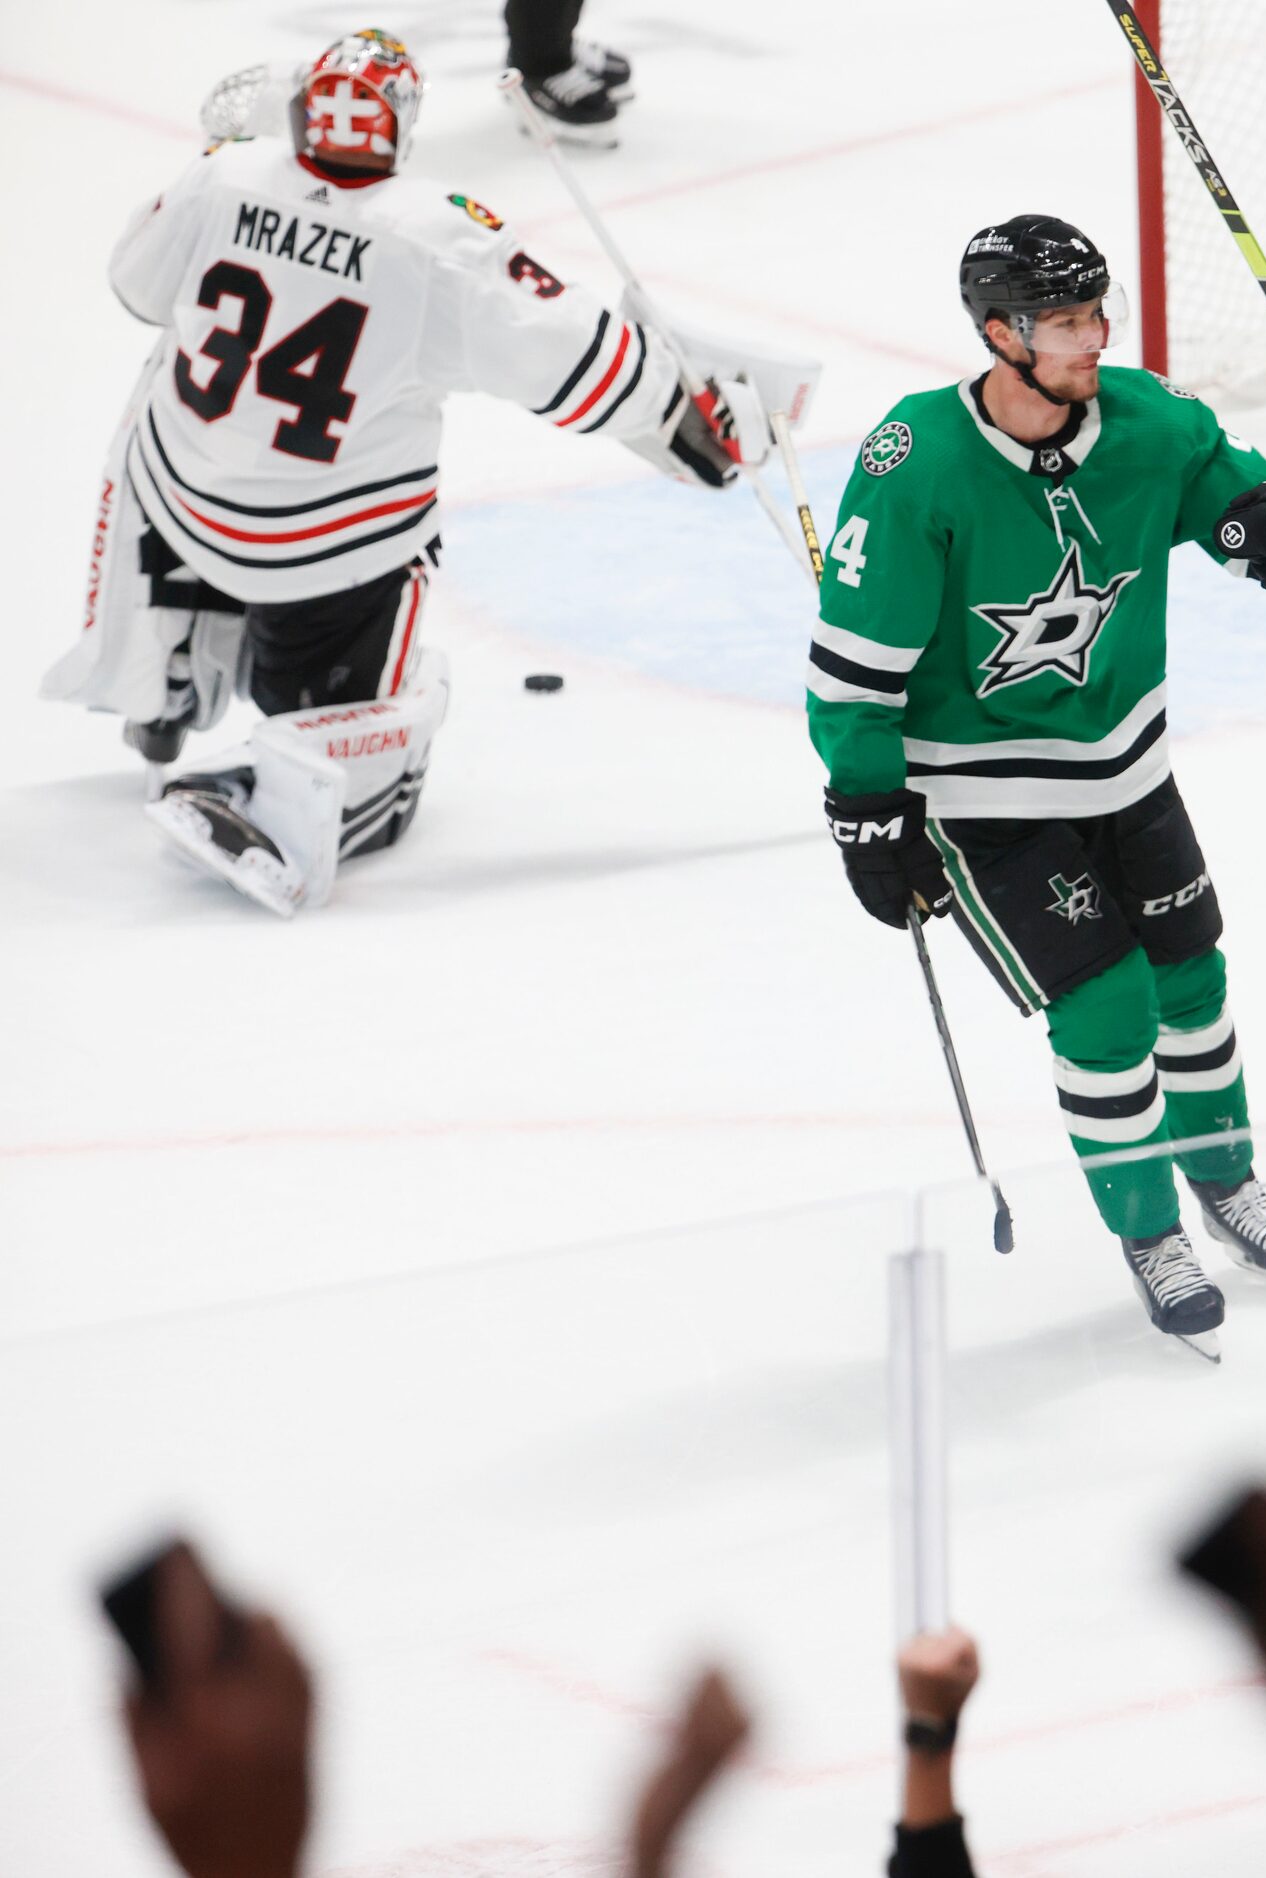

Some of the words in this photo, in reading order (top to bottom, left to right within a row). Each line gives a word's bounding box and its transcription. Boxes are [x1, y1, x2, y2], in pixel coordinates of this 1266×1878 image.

[1119, 13, 1158, 73] SUPER
[1149, 79, 1209, 164] TACKS
[233, 202, 372, 282] MRAZEK
[1078, 265, 1105, 282] CCM
[174, 259, 369, 464] 34
[829, 514, 870, 588] 4
